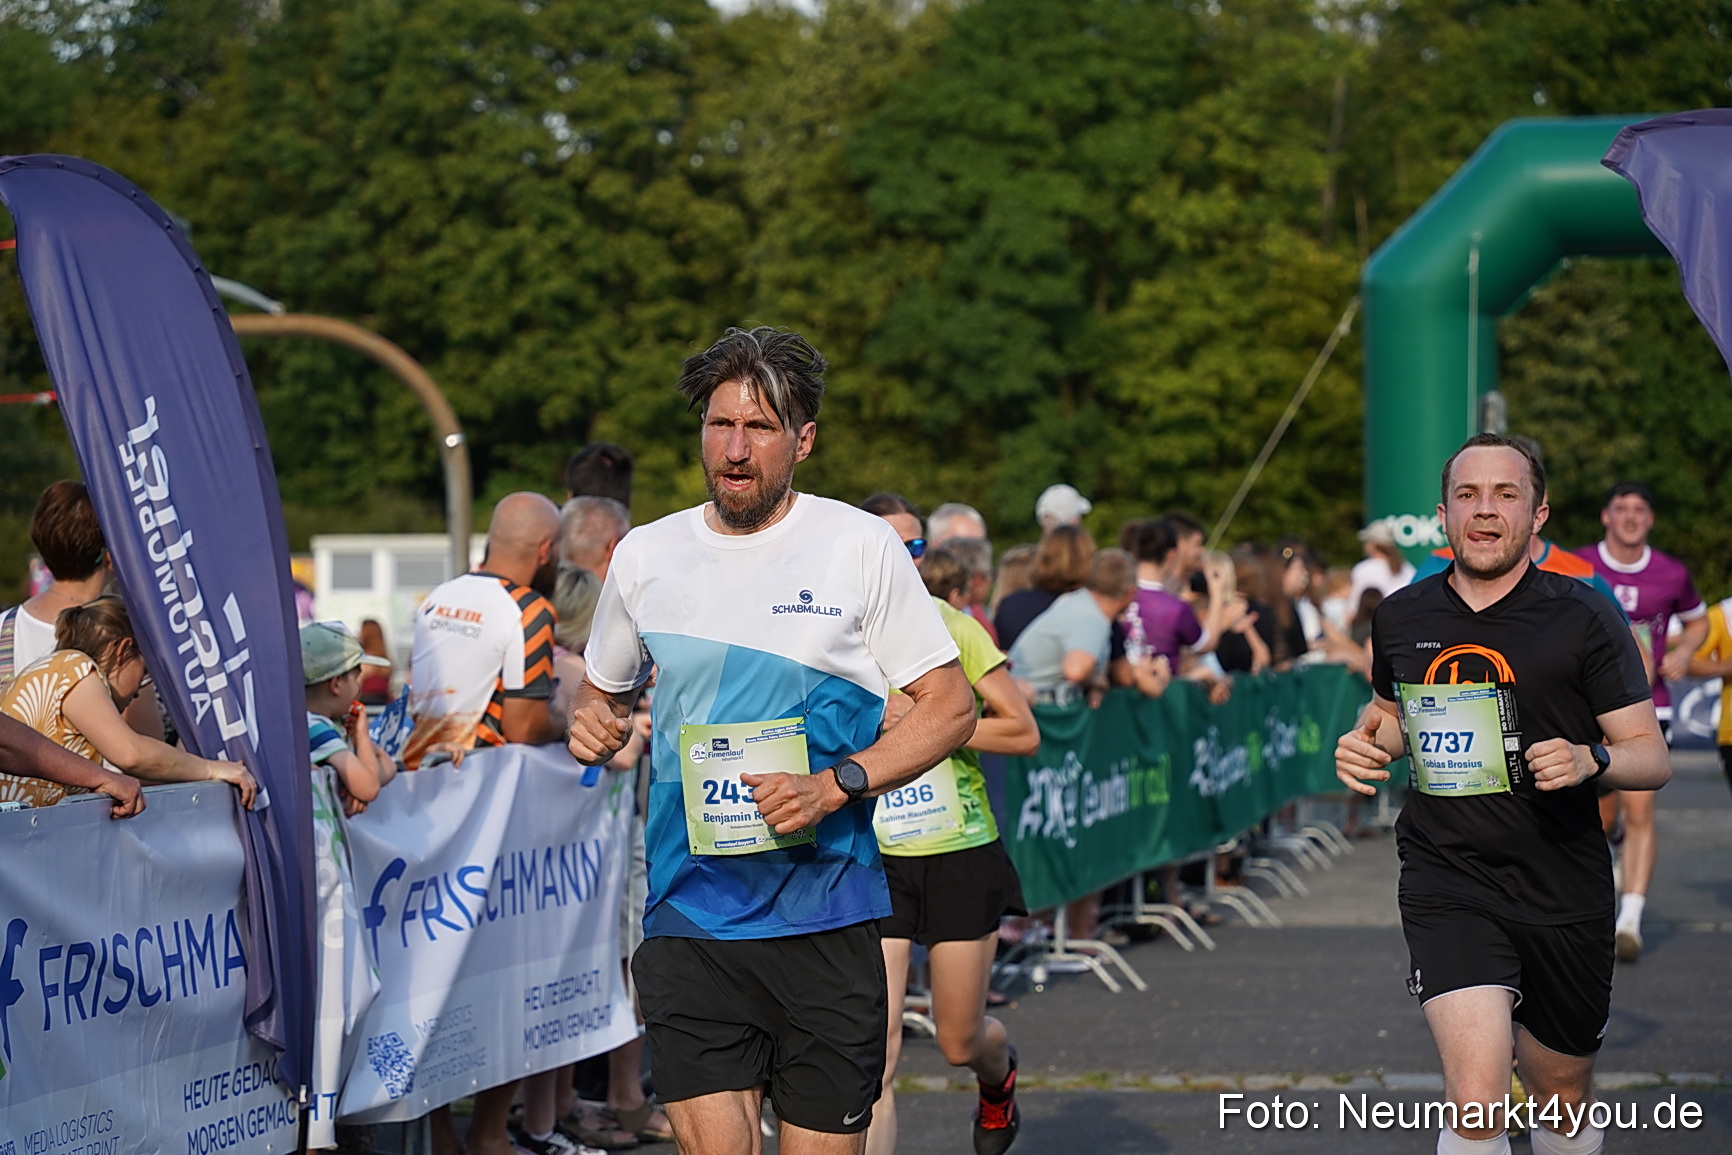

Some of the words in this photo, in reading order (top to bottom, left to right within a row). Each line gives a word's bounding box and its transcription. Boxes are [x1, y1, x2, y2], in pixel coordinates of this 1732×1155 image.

[771, 604, 843, 617] SCHABMÜLLER
[708, 748, 744, 758] Firmenlauf
[1418, 731, 1475, 753] 2737
[1422, 759, 1446, 768] Tobias
[1448, 760, 1483, 768] Brosius
[1509, 754, 1520, 784] HILTL
[884, 784, 934, 809] 1336
[703, 811, 751, 825] Benjamin
[401, 839, 601, 948] FRISCHMANN
[183, 1071, 230, 1113] HEUTE
[187, 1112, 245, 1155] MORGEN
